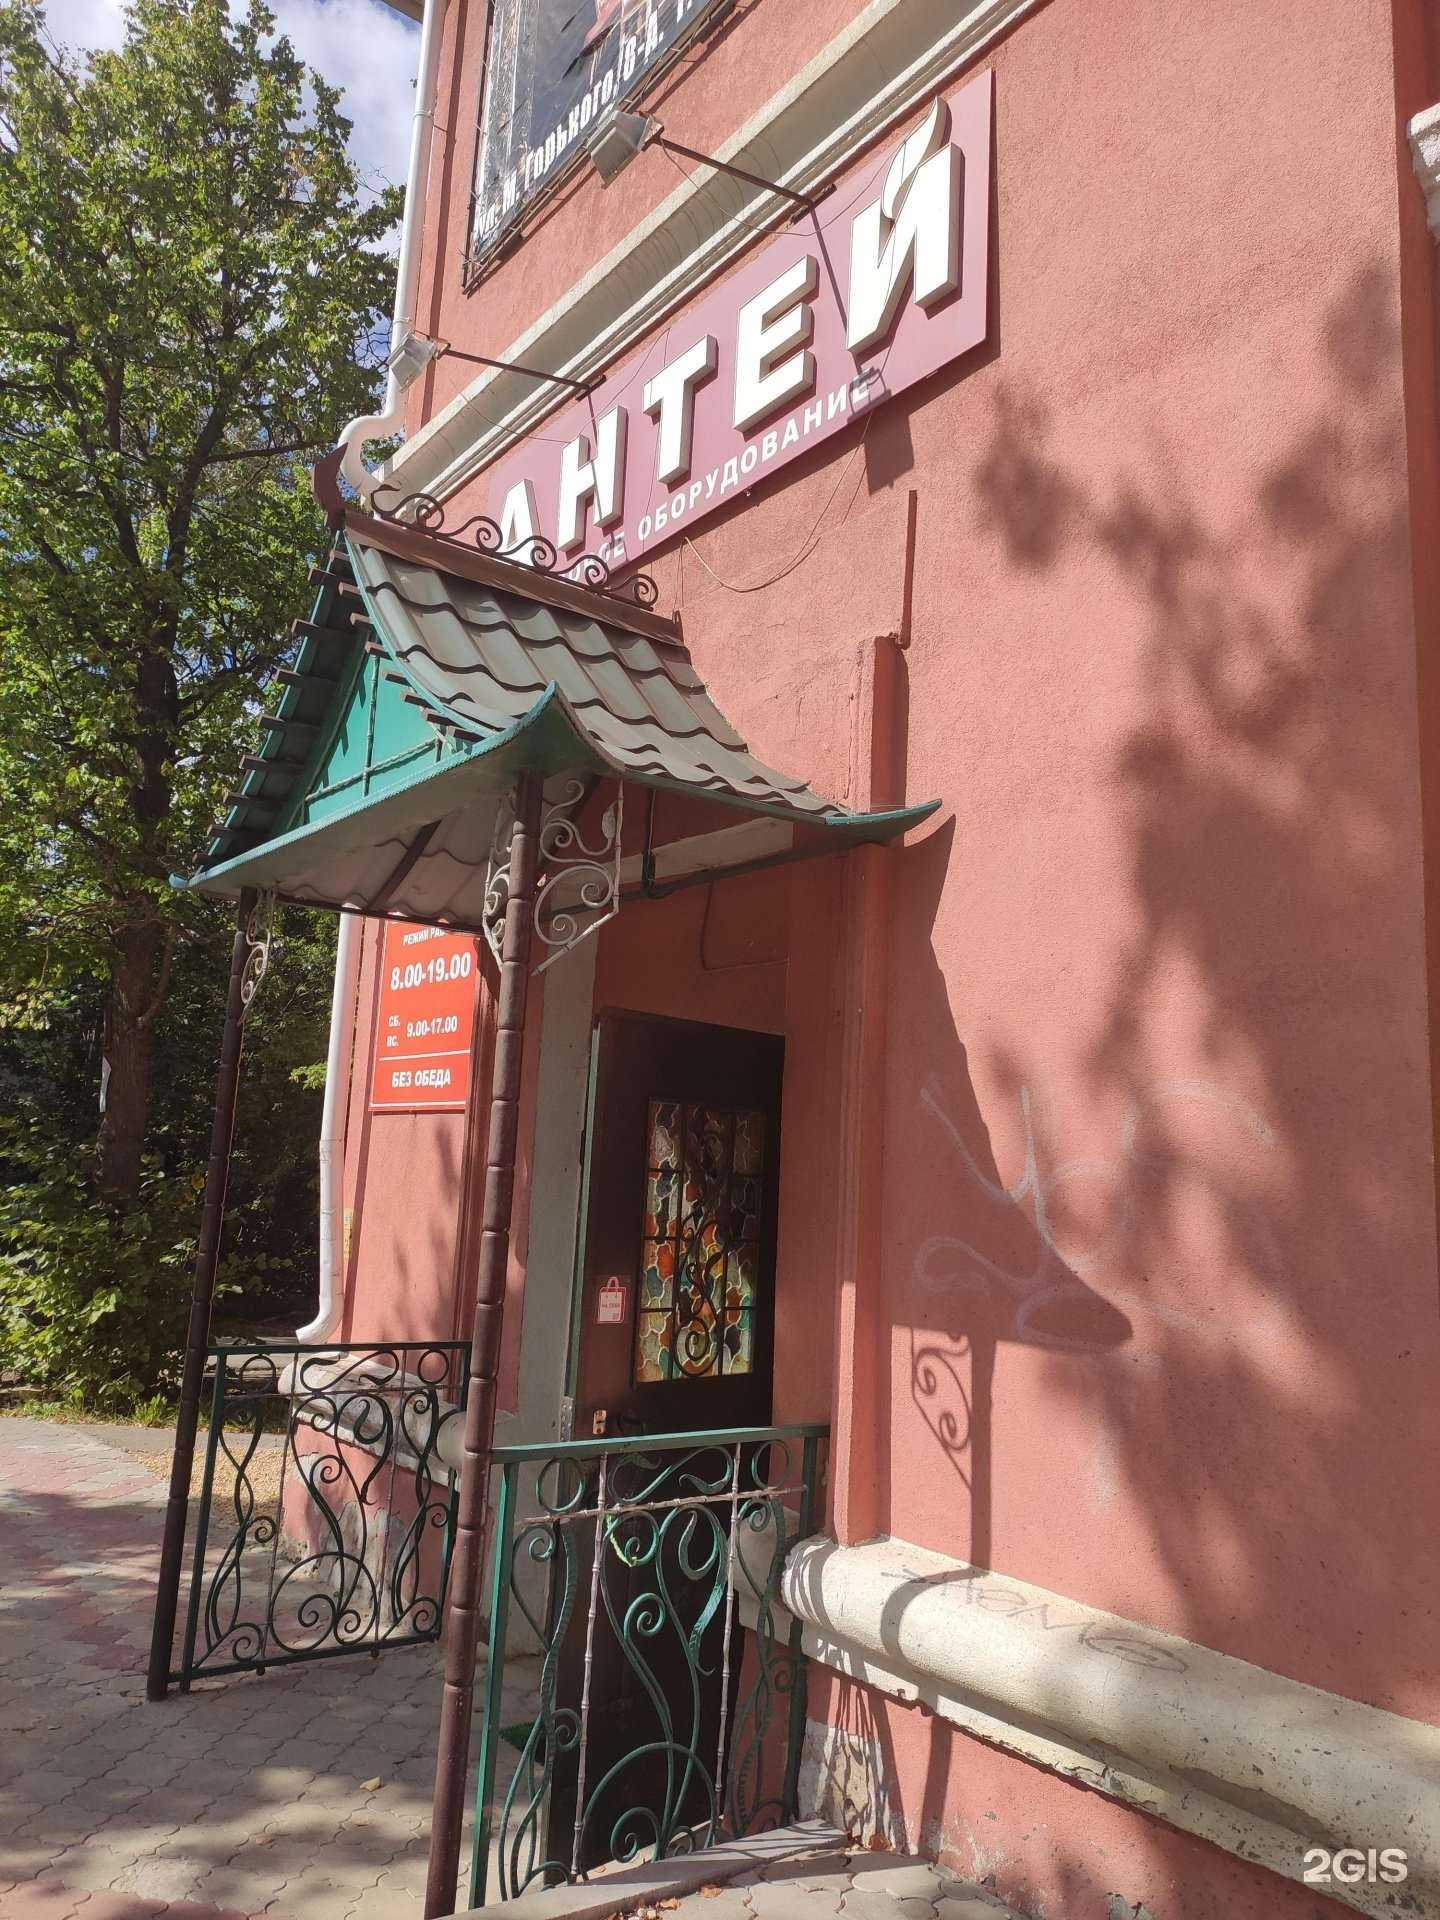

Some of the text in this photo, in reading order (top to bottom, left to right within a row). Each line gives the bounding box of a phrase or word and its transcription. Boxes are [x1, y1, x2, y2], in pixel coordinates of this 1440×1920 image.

[524, 69, 620, 191] Горького,
[496, 95, 965, 568] АНТЕЙ
[637, 381, 870, 541] ОБОРУДОВАНИЕ
[403, 928, 429, 946] РЕЖИМ
[390, 951, 472, 991] 8.00-19.00
[406, 1015, 458, 1038] 9.00-17.00
[391, 1067, 451, 1088] БЕЗ ОБЕДА
